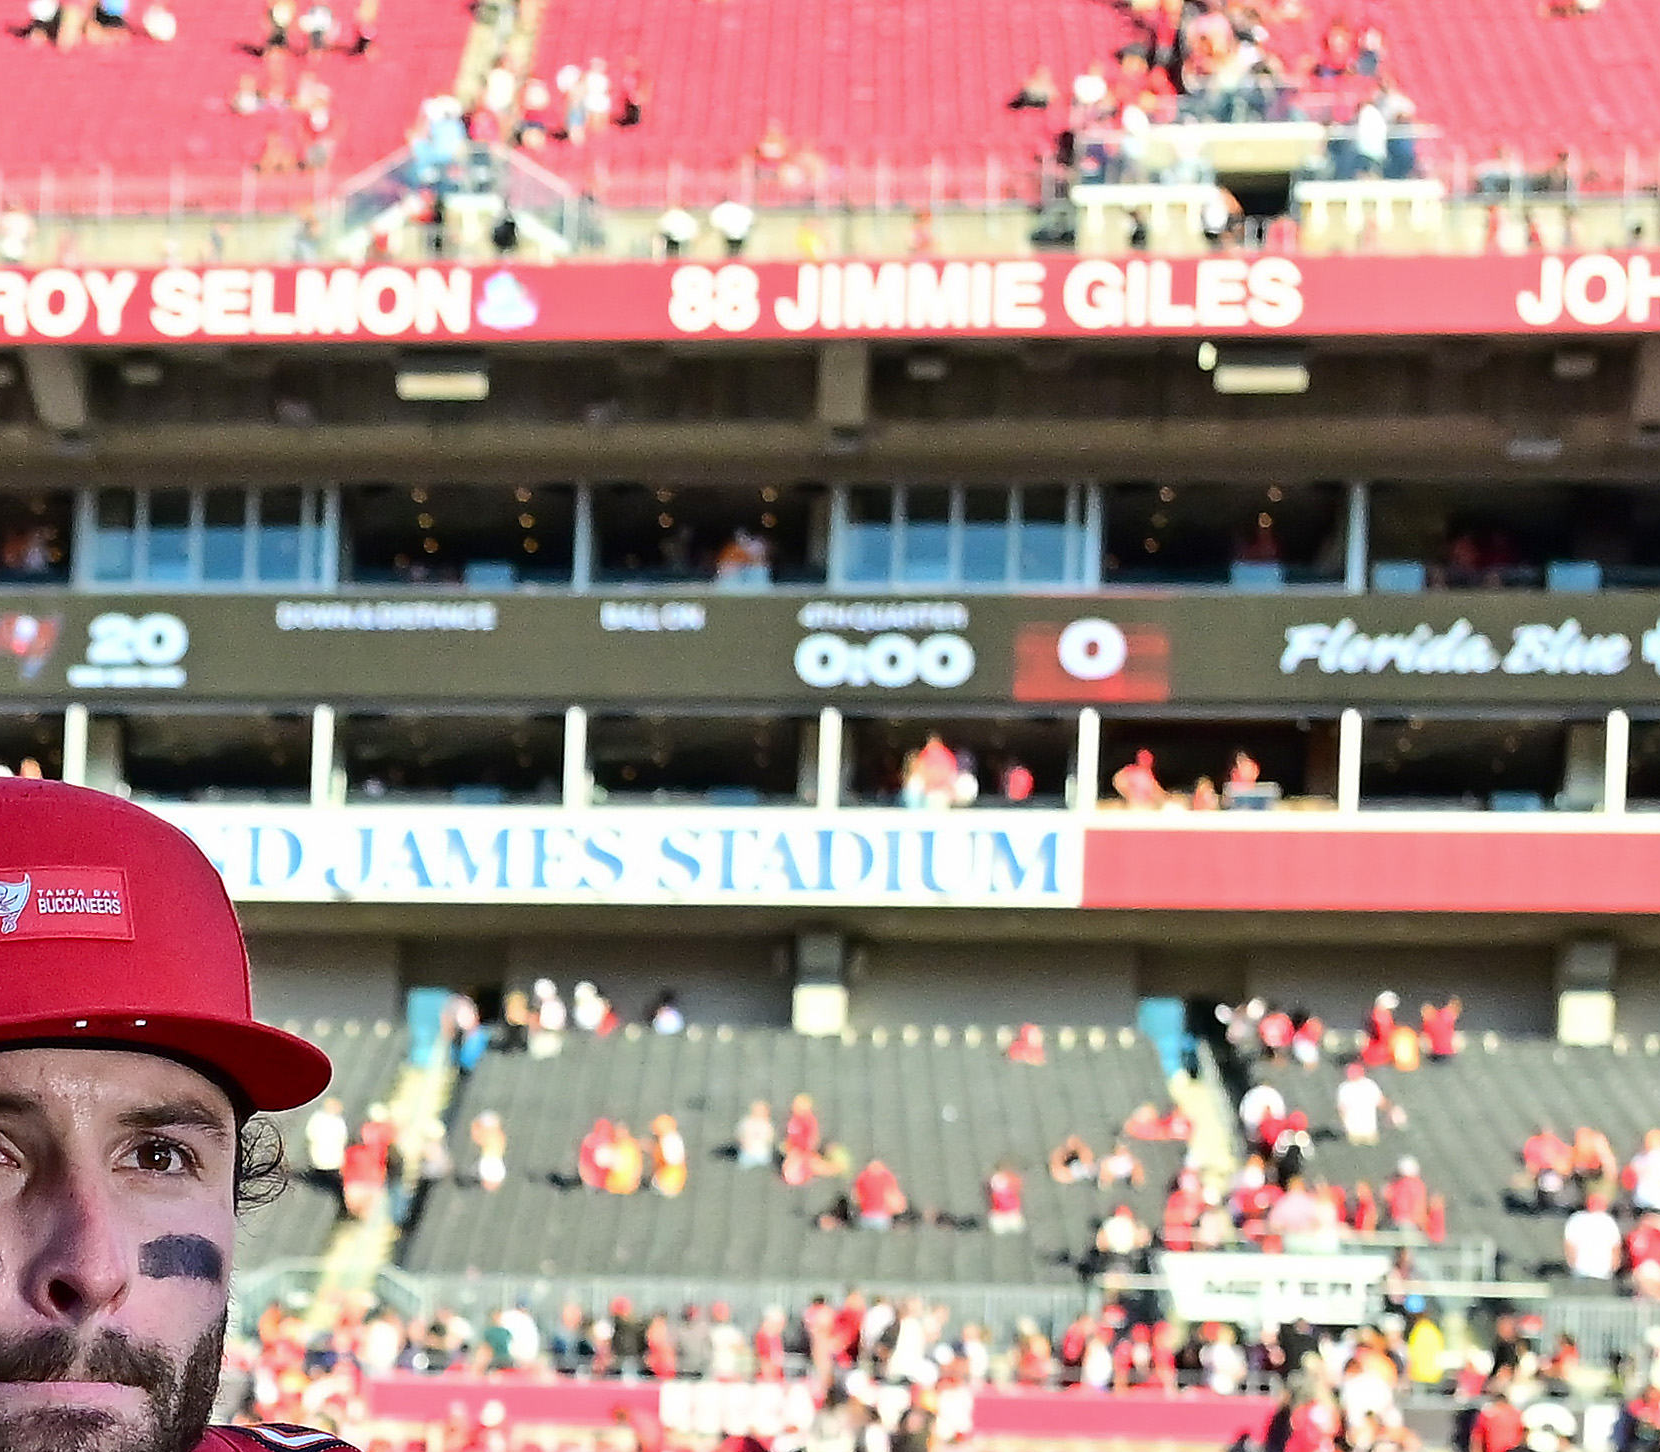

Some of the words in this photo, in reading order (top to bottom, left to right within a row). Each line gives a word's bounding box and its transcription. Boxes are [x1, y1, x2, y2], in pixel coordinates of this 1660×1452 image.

[149, 268, 471, 337] SELMON
[775, 263, 1046, 332] JIMMIE
[1063, 259, 1304, 330] GILES
[88, 613, 189, 666] 20
[794, 632, 976, 689] 0:00
[1057, 618, 1128, 680] 0
[323, 826, 626, 893] JAMES
[656, 828, 1060, 894] STADIUM
[37, 889, 84, 898] TAMPA
[93, 890, 118, 898] BAY
[37, 898, 122, 914] BUCCANEERS
